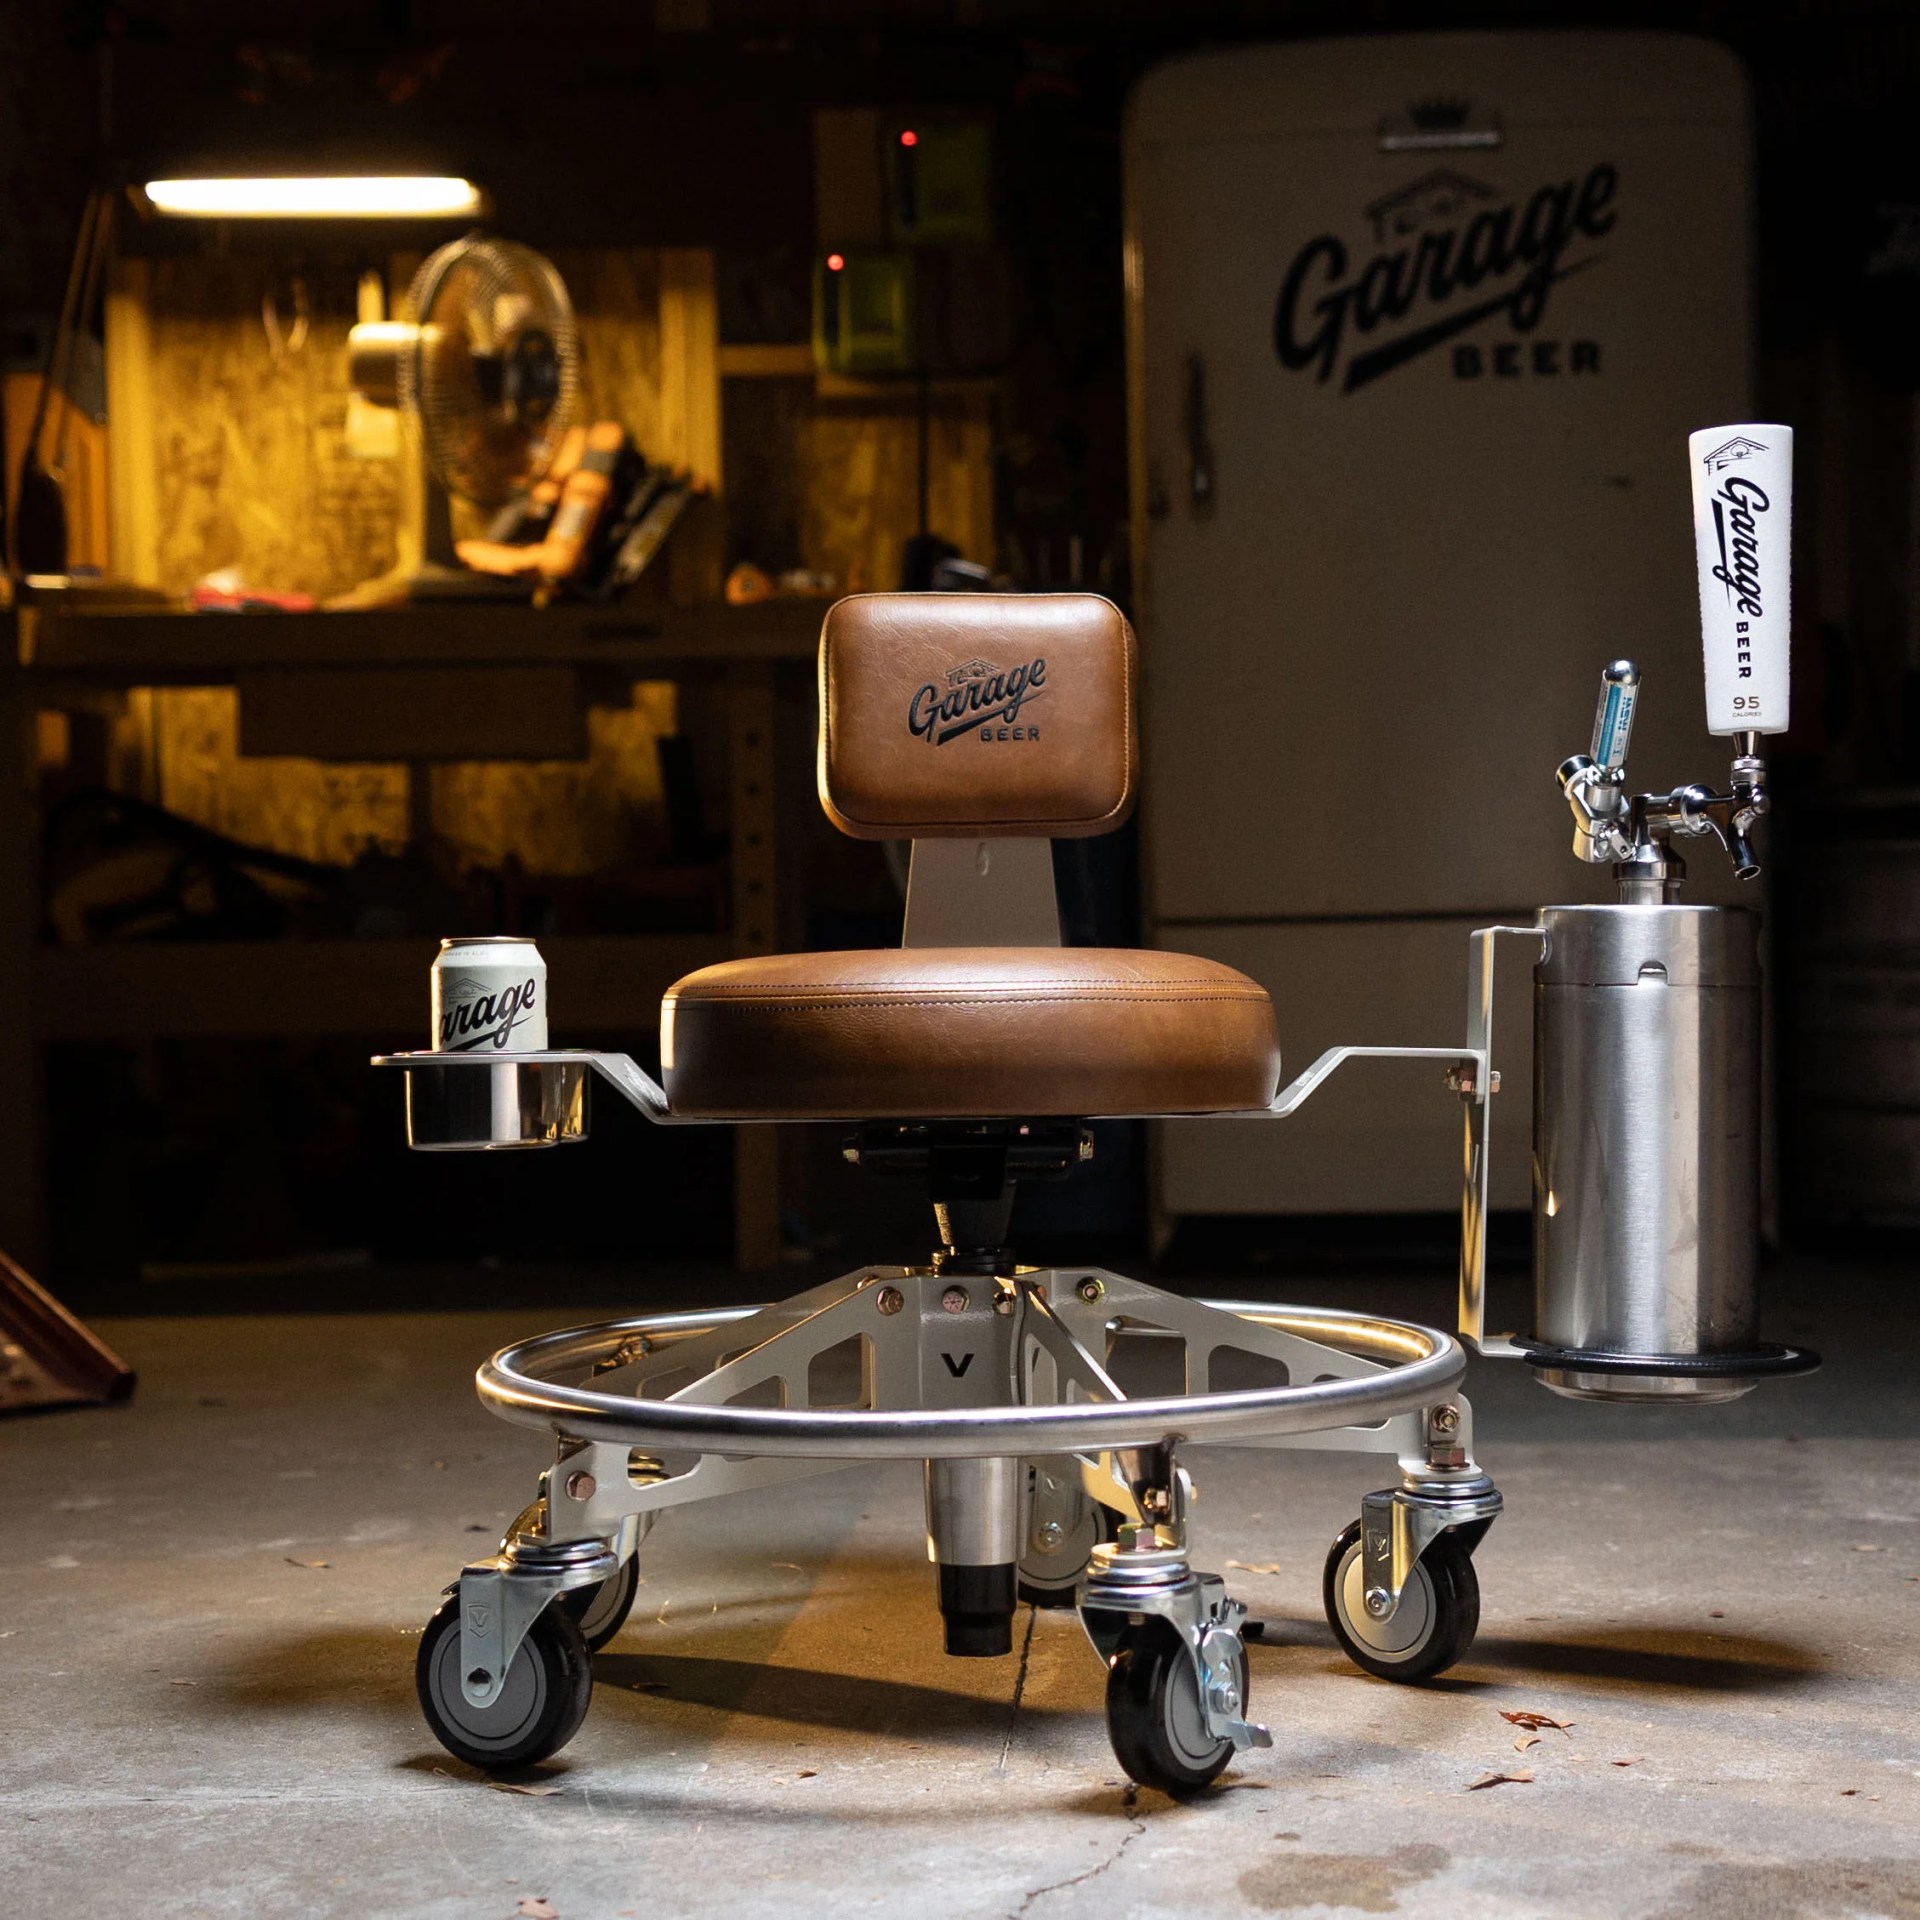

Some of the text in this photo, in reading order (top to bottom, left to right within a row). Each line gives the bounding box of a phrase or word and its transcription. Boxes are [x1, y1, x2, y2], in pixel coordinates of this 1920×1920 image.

[1273, 163, 1618, 394] Garage
[1452, 341, 1602, 380] BEER
[1711, 476, 1770, 679] Garage BEER
[908, 658, 1046, 746] Garage
[1733, 696, 1760, 710] 95
[980, 727, 1040, 742] BEER
[940, 1353, 974, 1378] V
